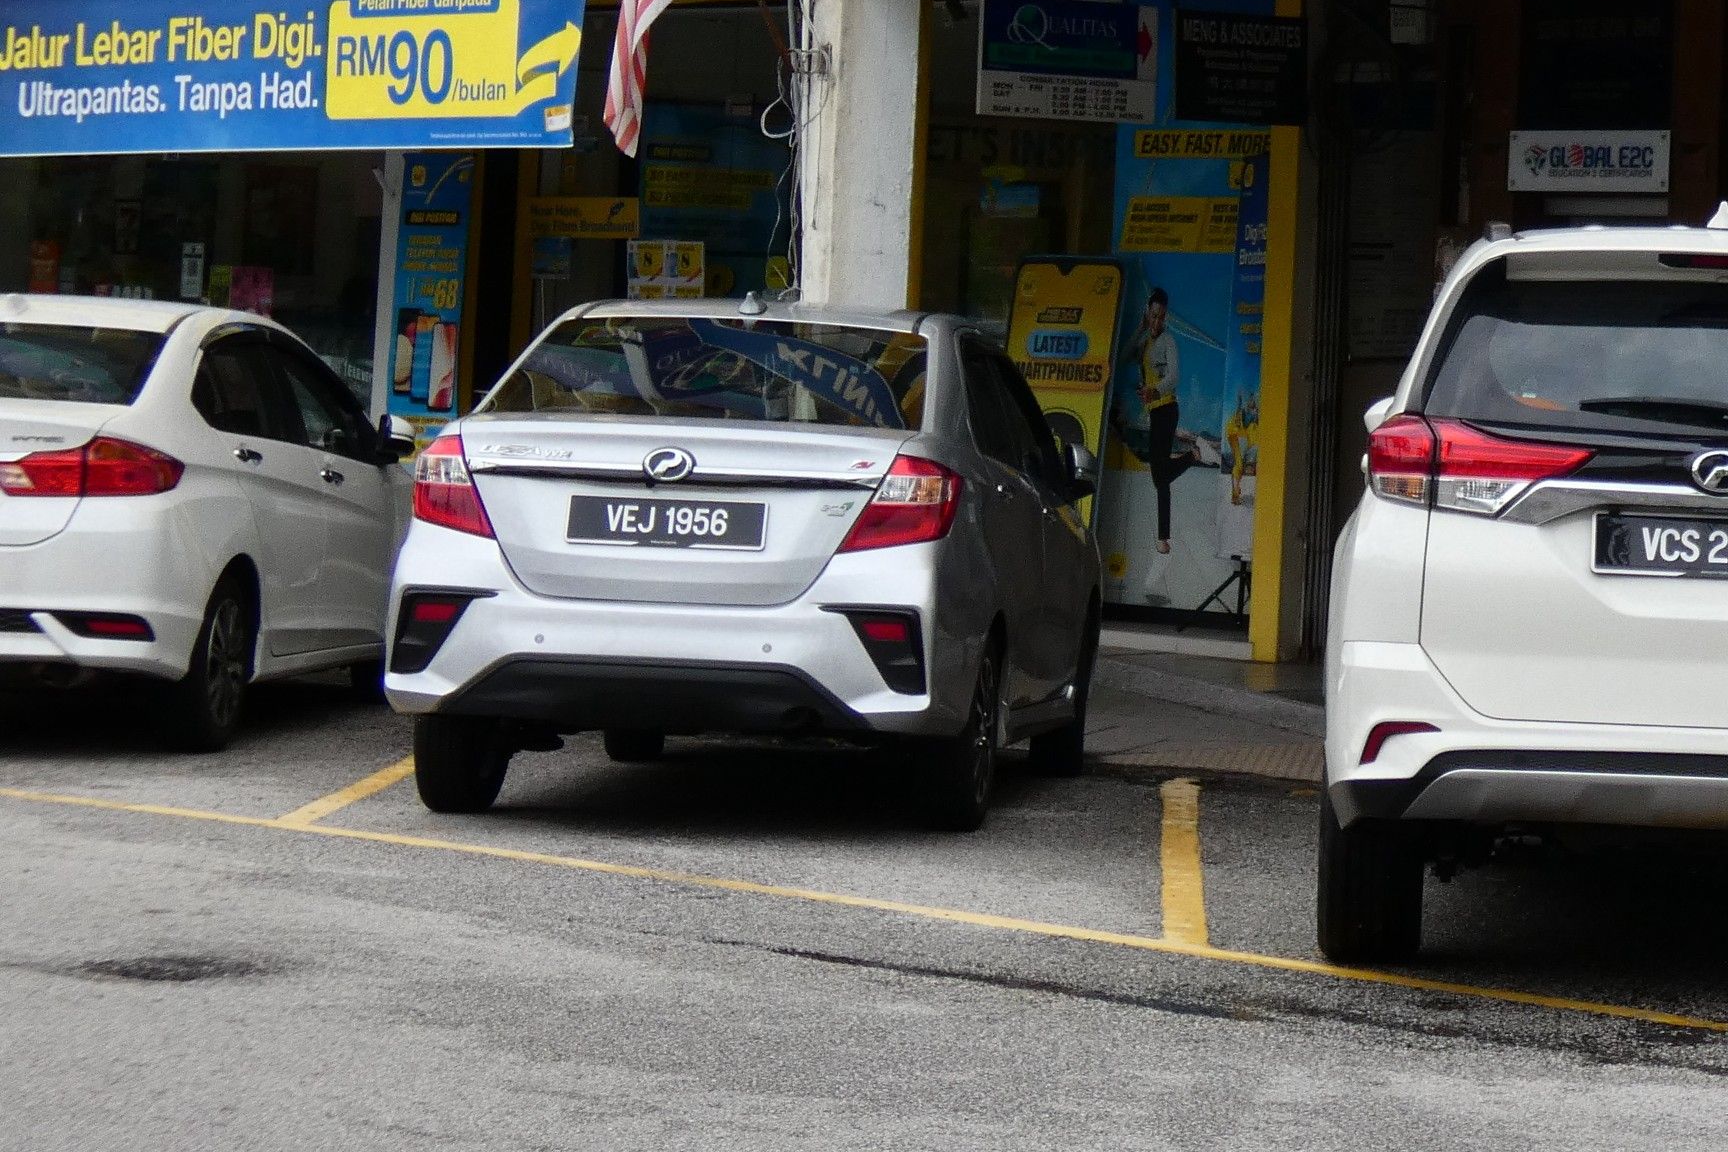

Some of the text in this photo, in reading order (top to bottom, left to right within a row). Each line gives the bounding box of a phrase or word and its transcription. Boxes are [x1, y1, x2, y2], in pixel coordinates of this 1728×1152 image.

[0, 11, 321, 70] Jalur Lebar Fiber Digi.
[1183, 18, 1217, 42] MENG
[1230, 22, 1302, 48] ASSOCIATES
[18, 70, 318, 123] Ultrapantas. Tanpa Had.
[1549, 144, 1654, 169] GLOBAL E2C
[1033, 334, 1081, 355] LATEST
[606, 504, 728, 537] VEJ 1956
[1641, 526, 1700, 564] VCS
